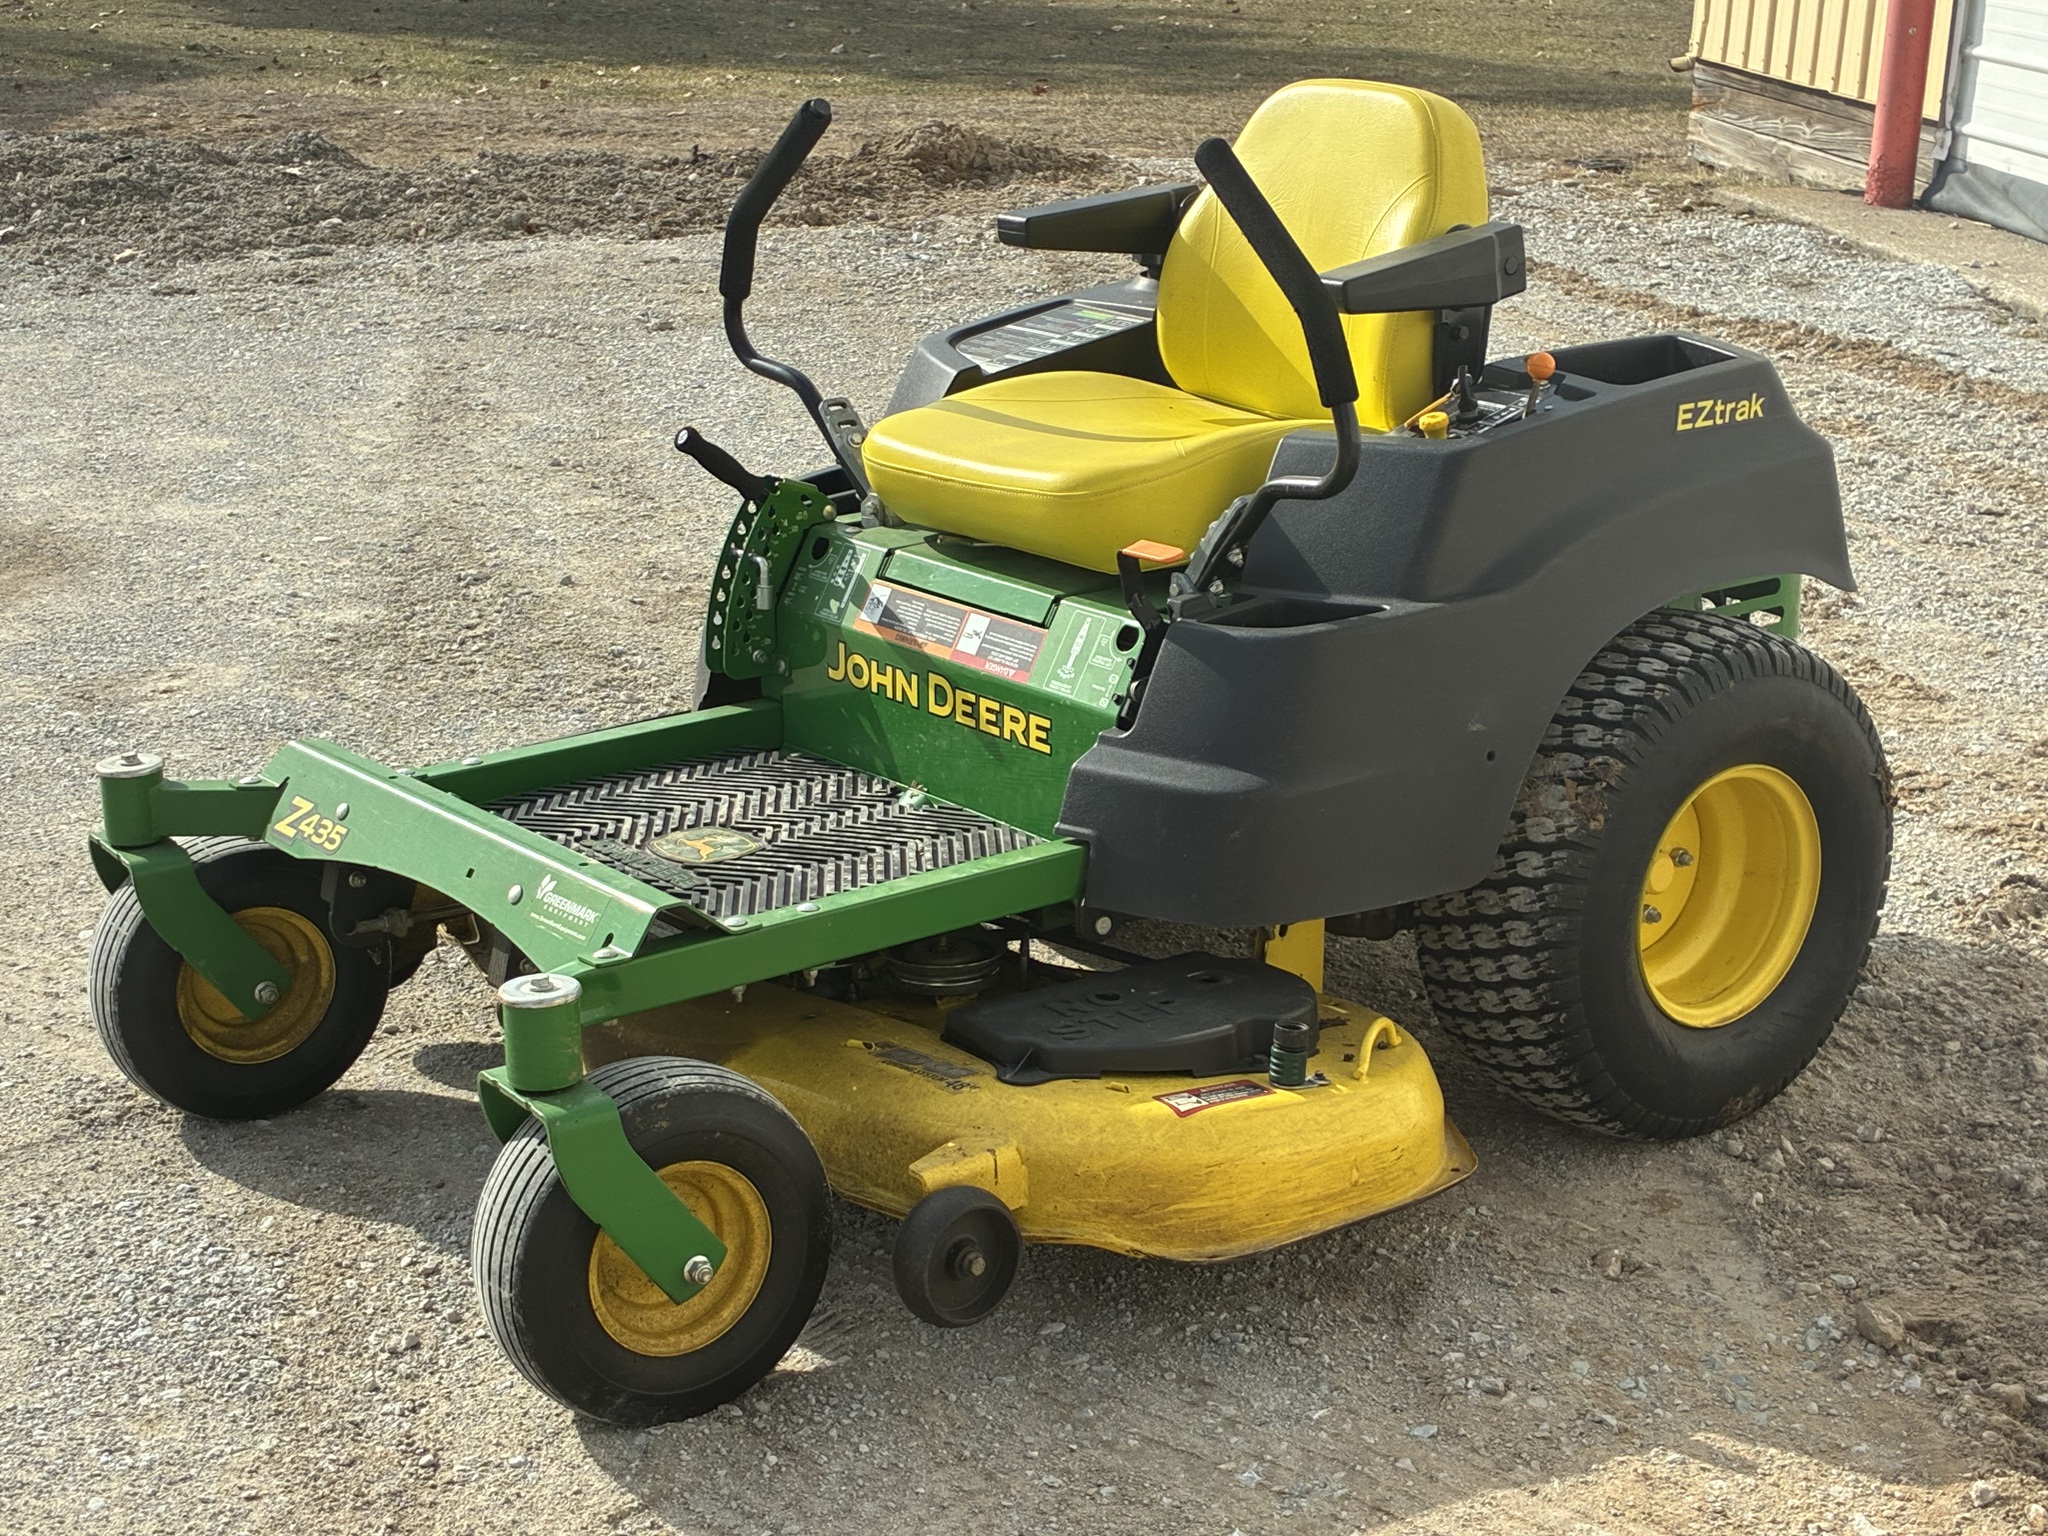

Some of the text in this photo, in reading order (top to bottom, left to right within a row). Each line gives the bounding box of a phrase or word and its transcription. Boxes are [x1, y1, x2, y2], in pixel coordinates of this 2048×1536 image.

[1676, 392, 1766, 432] EZtrak
[827, 641, 920, 709] JOHN
[927, 670, 1052, 756] DEERE
[273, 795, 349, 852] Z435
[543, 891, 600, 923] GREENMARK
[543, 904, 589, 928] EQUIPMENT
[1047, 999, 1177, 1041] STEP
